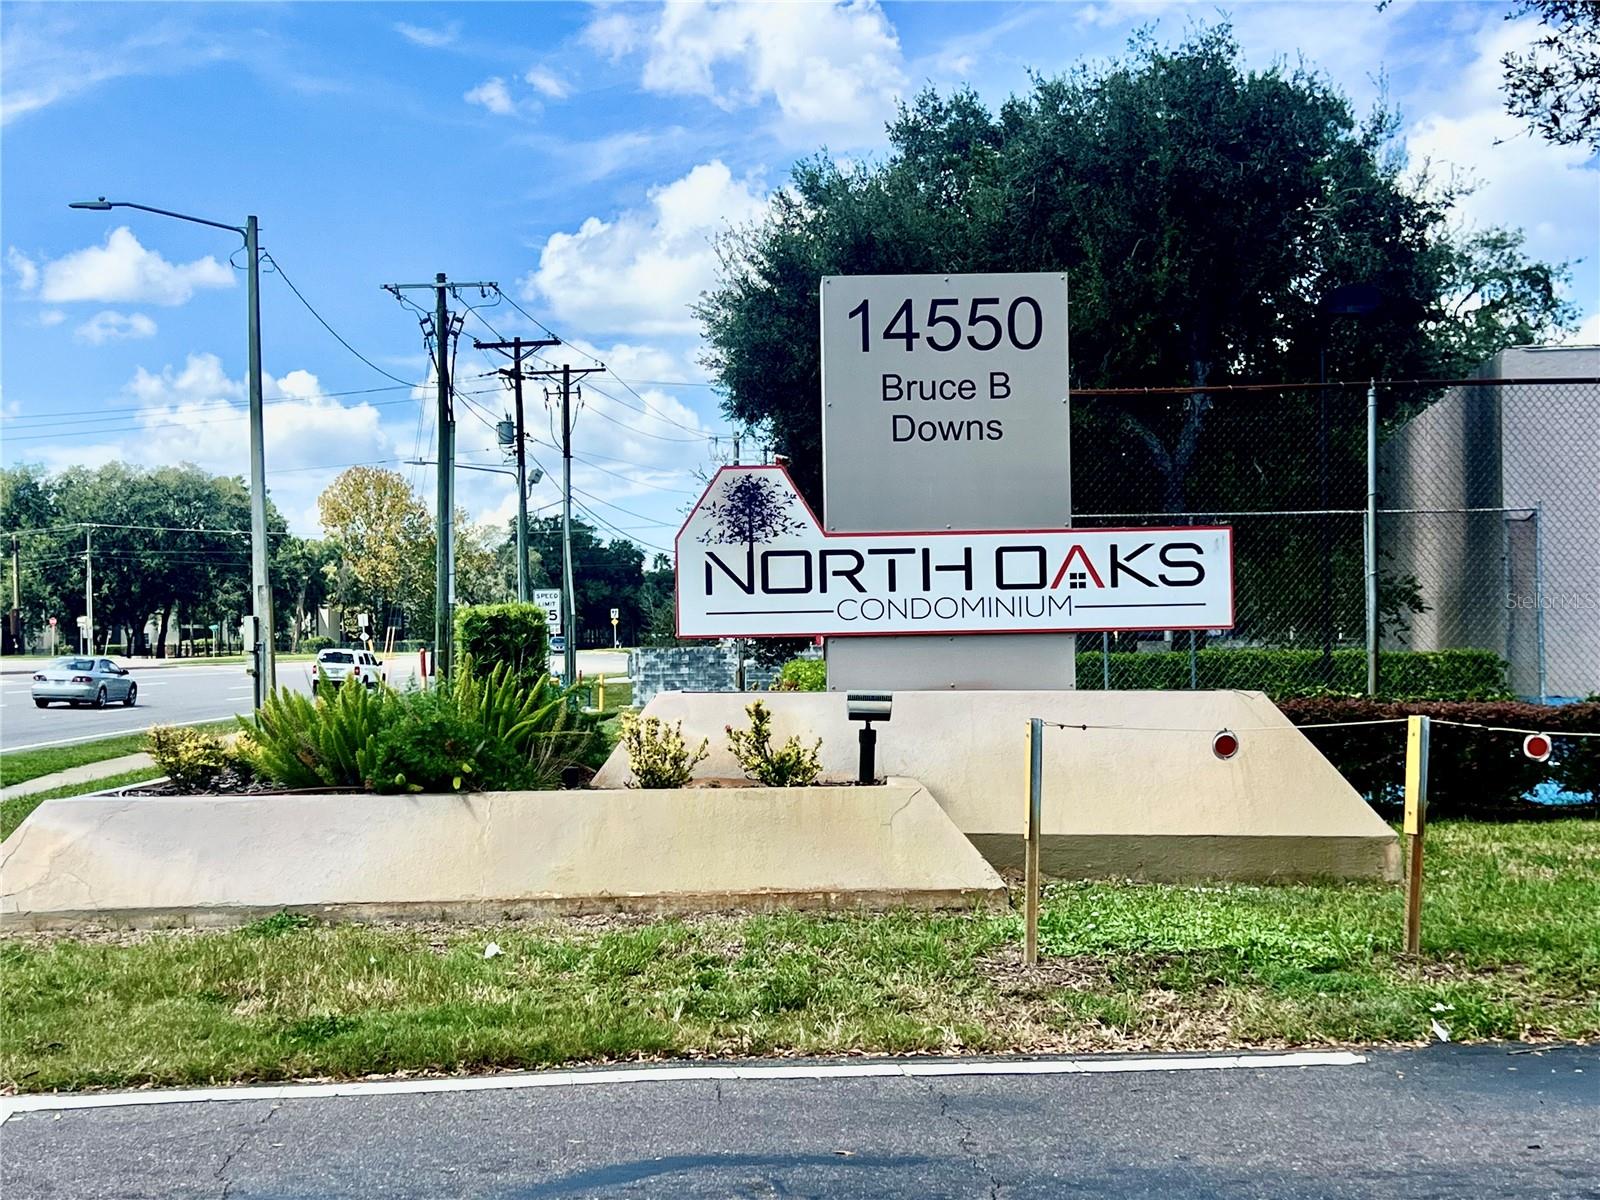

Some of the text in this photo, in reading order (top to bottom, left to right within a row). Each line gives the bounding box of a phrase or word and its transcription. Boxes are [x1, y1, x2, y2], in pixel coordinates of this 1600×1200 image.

[848, 296, 1043, 352] 14550
[882, 371, 1011, 401] Bruce B
[892, 414, 1003, 442] Downs
[705, 542, 1206, 595] NORTH OAKS
[549, 609, 558, 621] 5
[837, 595, 1072, 621] CONDOMINIUM
